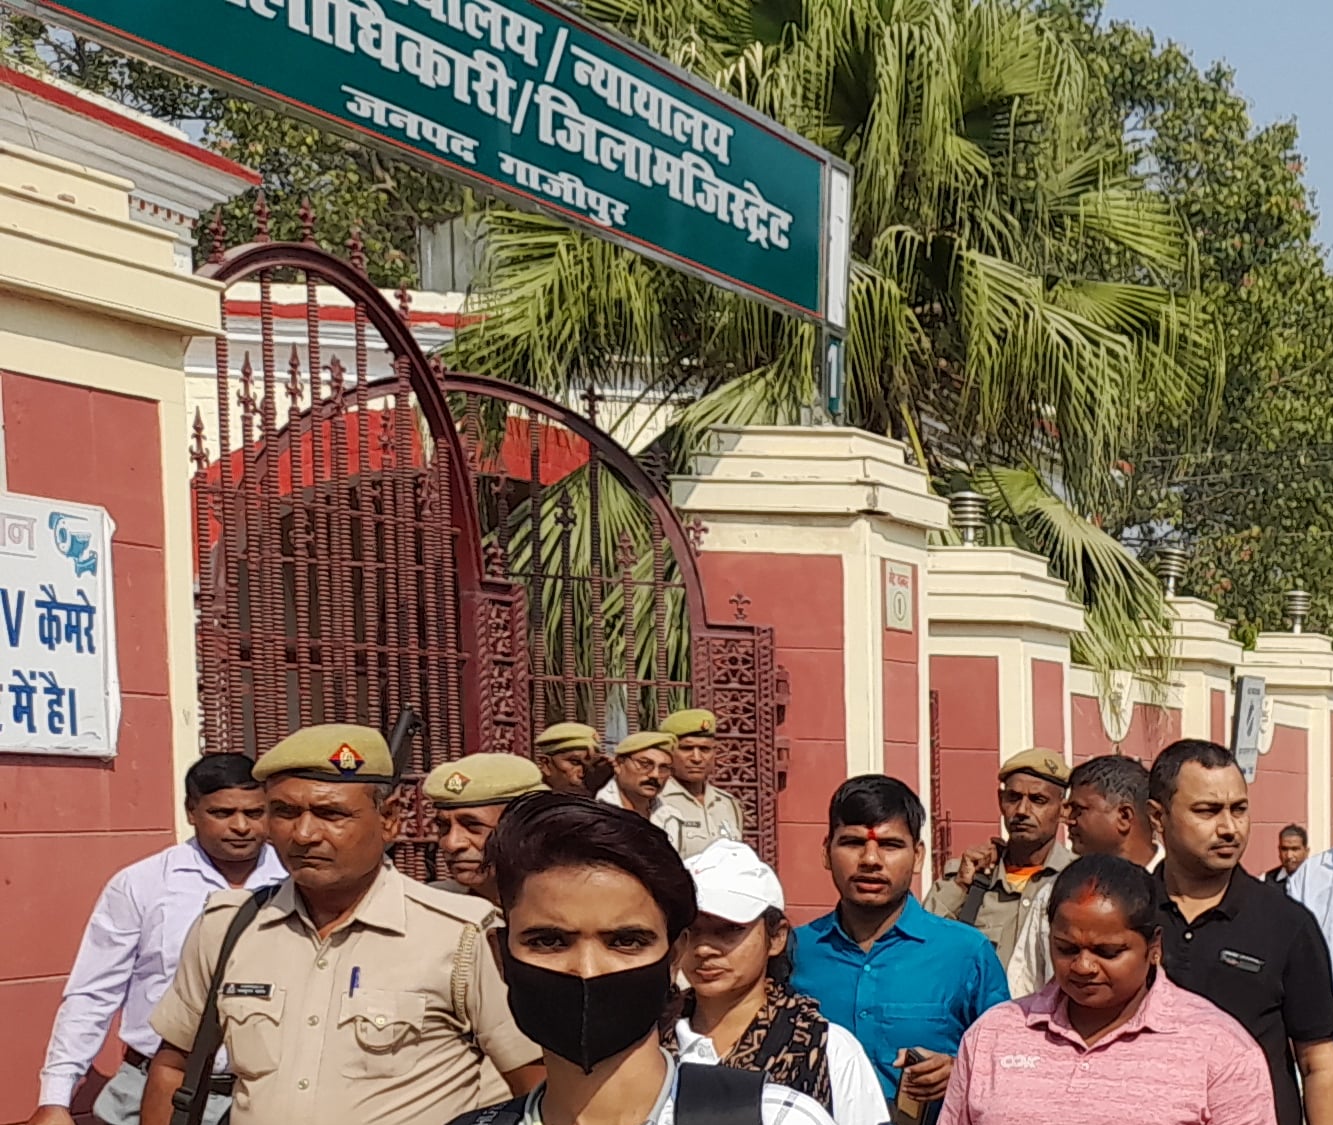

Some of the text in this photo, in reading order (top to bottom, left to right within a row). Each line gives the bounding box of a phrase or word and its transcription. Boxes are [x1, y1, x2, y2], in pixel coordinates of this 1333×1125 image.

[570, 45, 733, 165] न्यायालय
[341, 85, 629, 226] जनपद गाजीपुर
[35, 585, 96, 654] कैमरे
[9, 670, 37, 734] में
